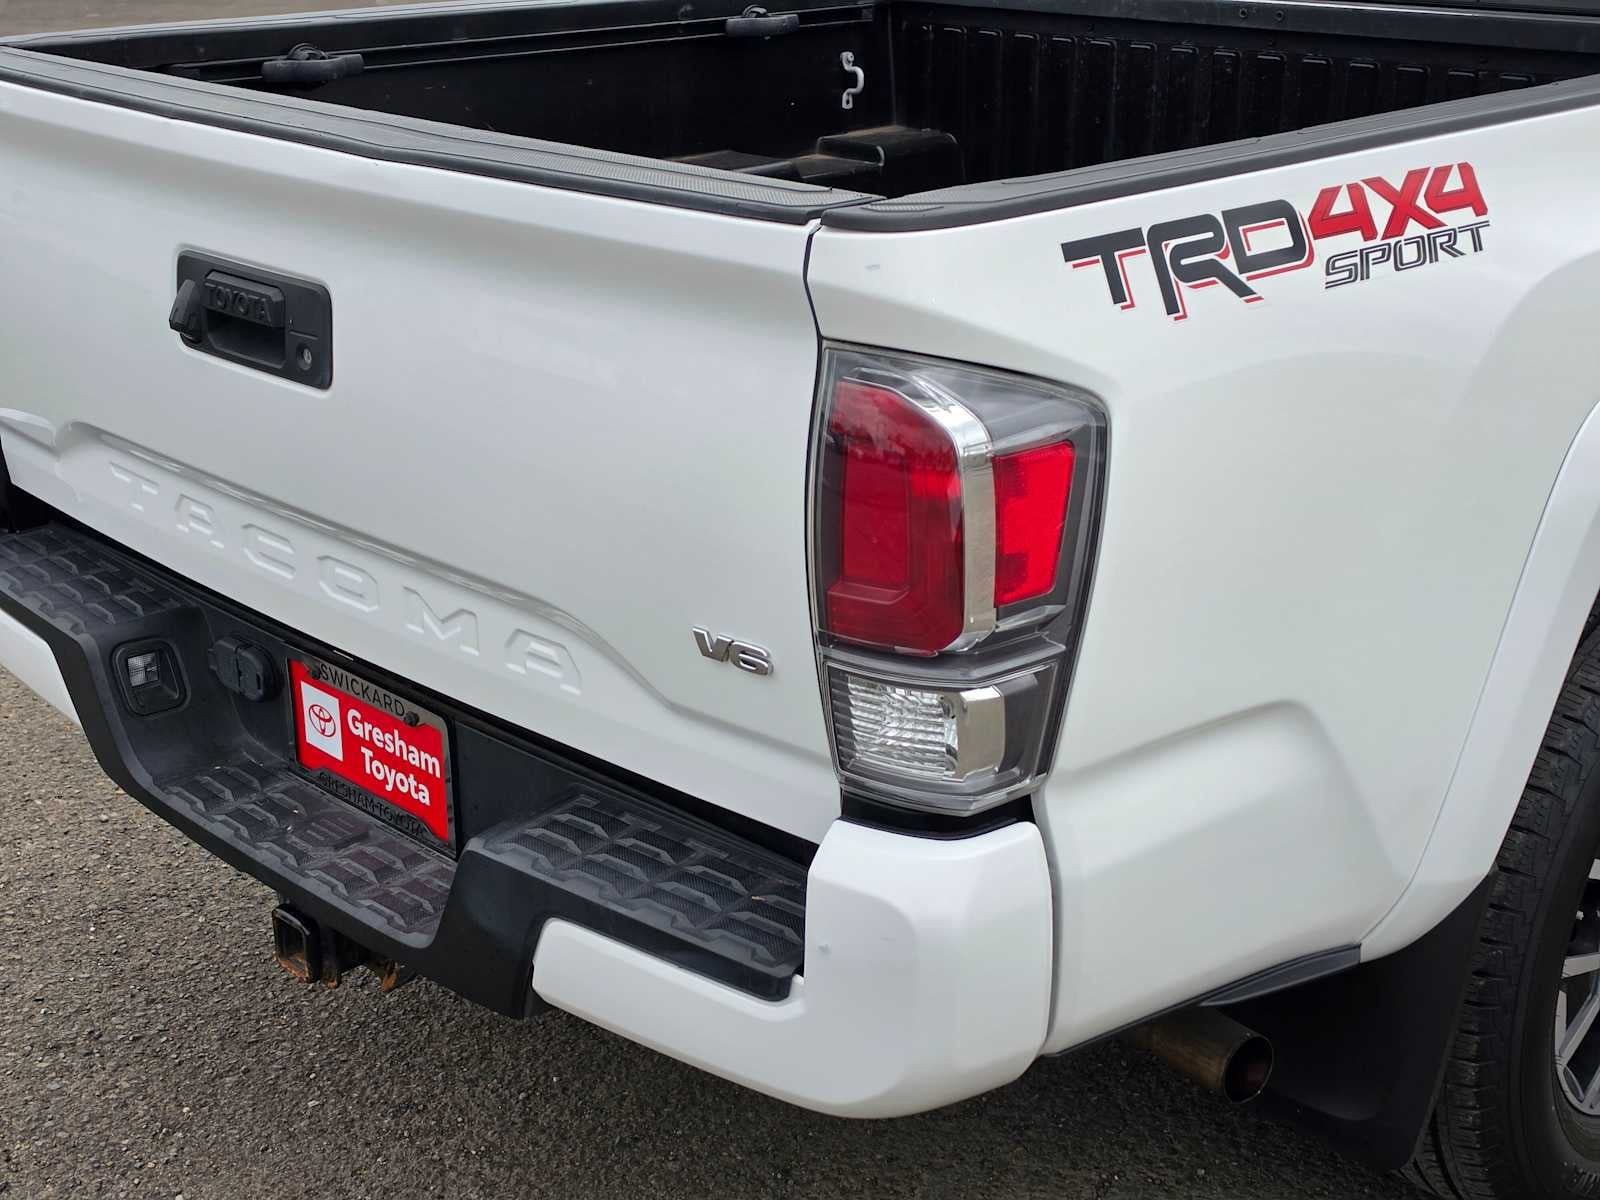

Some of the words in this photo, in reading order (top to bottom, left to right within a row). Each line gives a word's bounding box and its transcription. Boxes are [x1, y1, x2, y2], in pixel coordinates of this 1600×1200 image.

[1061, 199, 1314, 320] TRD
[1307, 162, 1488, 242] 4X4
[1325, 220, 1490, 290] SPORT
[204, 282, 273, 324] TOYOTA
[109, 461, 583, 696] TACOMA
[692, 626, 774, 676] V6
[319, 663, 405, 718] SWICKARD
[346, 708, 441, 779] Gresham
[360, 746, 431, 806] Toyota
